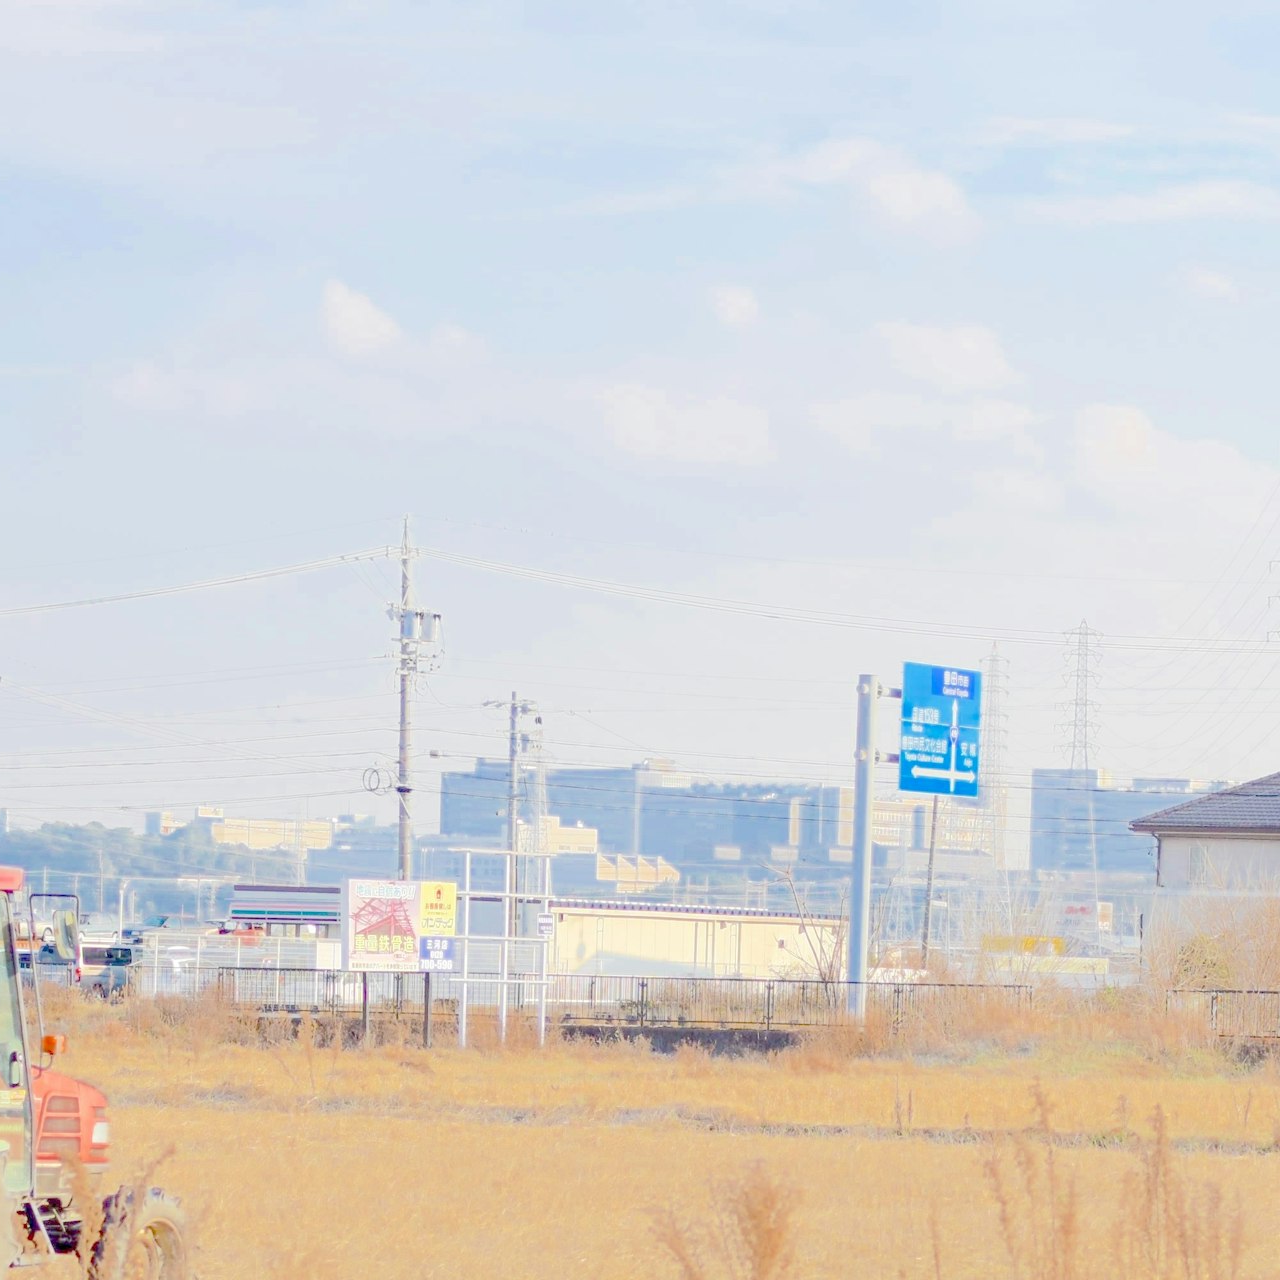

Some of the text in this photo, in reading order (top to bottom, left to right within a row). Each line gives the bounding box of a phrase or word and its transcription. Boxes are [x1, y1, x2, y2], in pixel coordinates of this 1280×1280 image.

[354, 934, 414, 952] 重量鉄骨造
